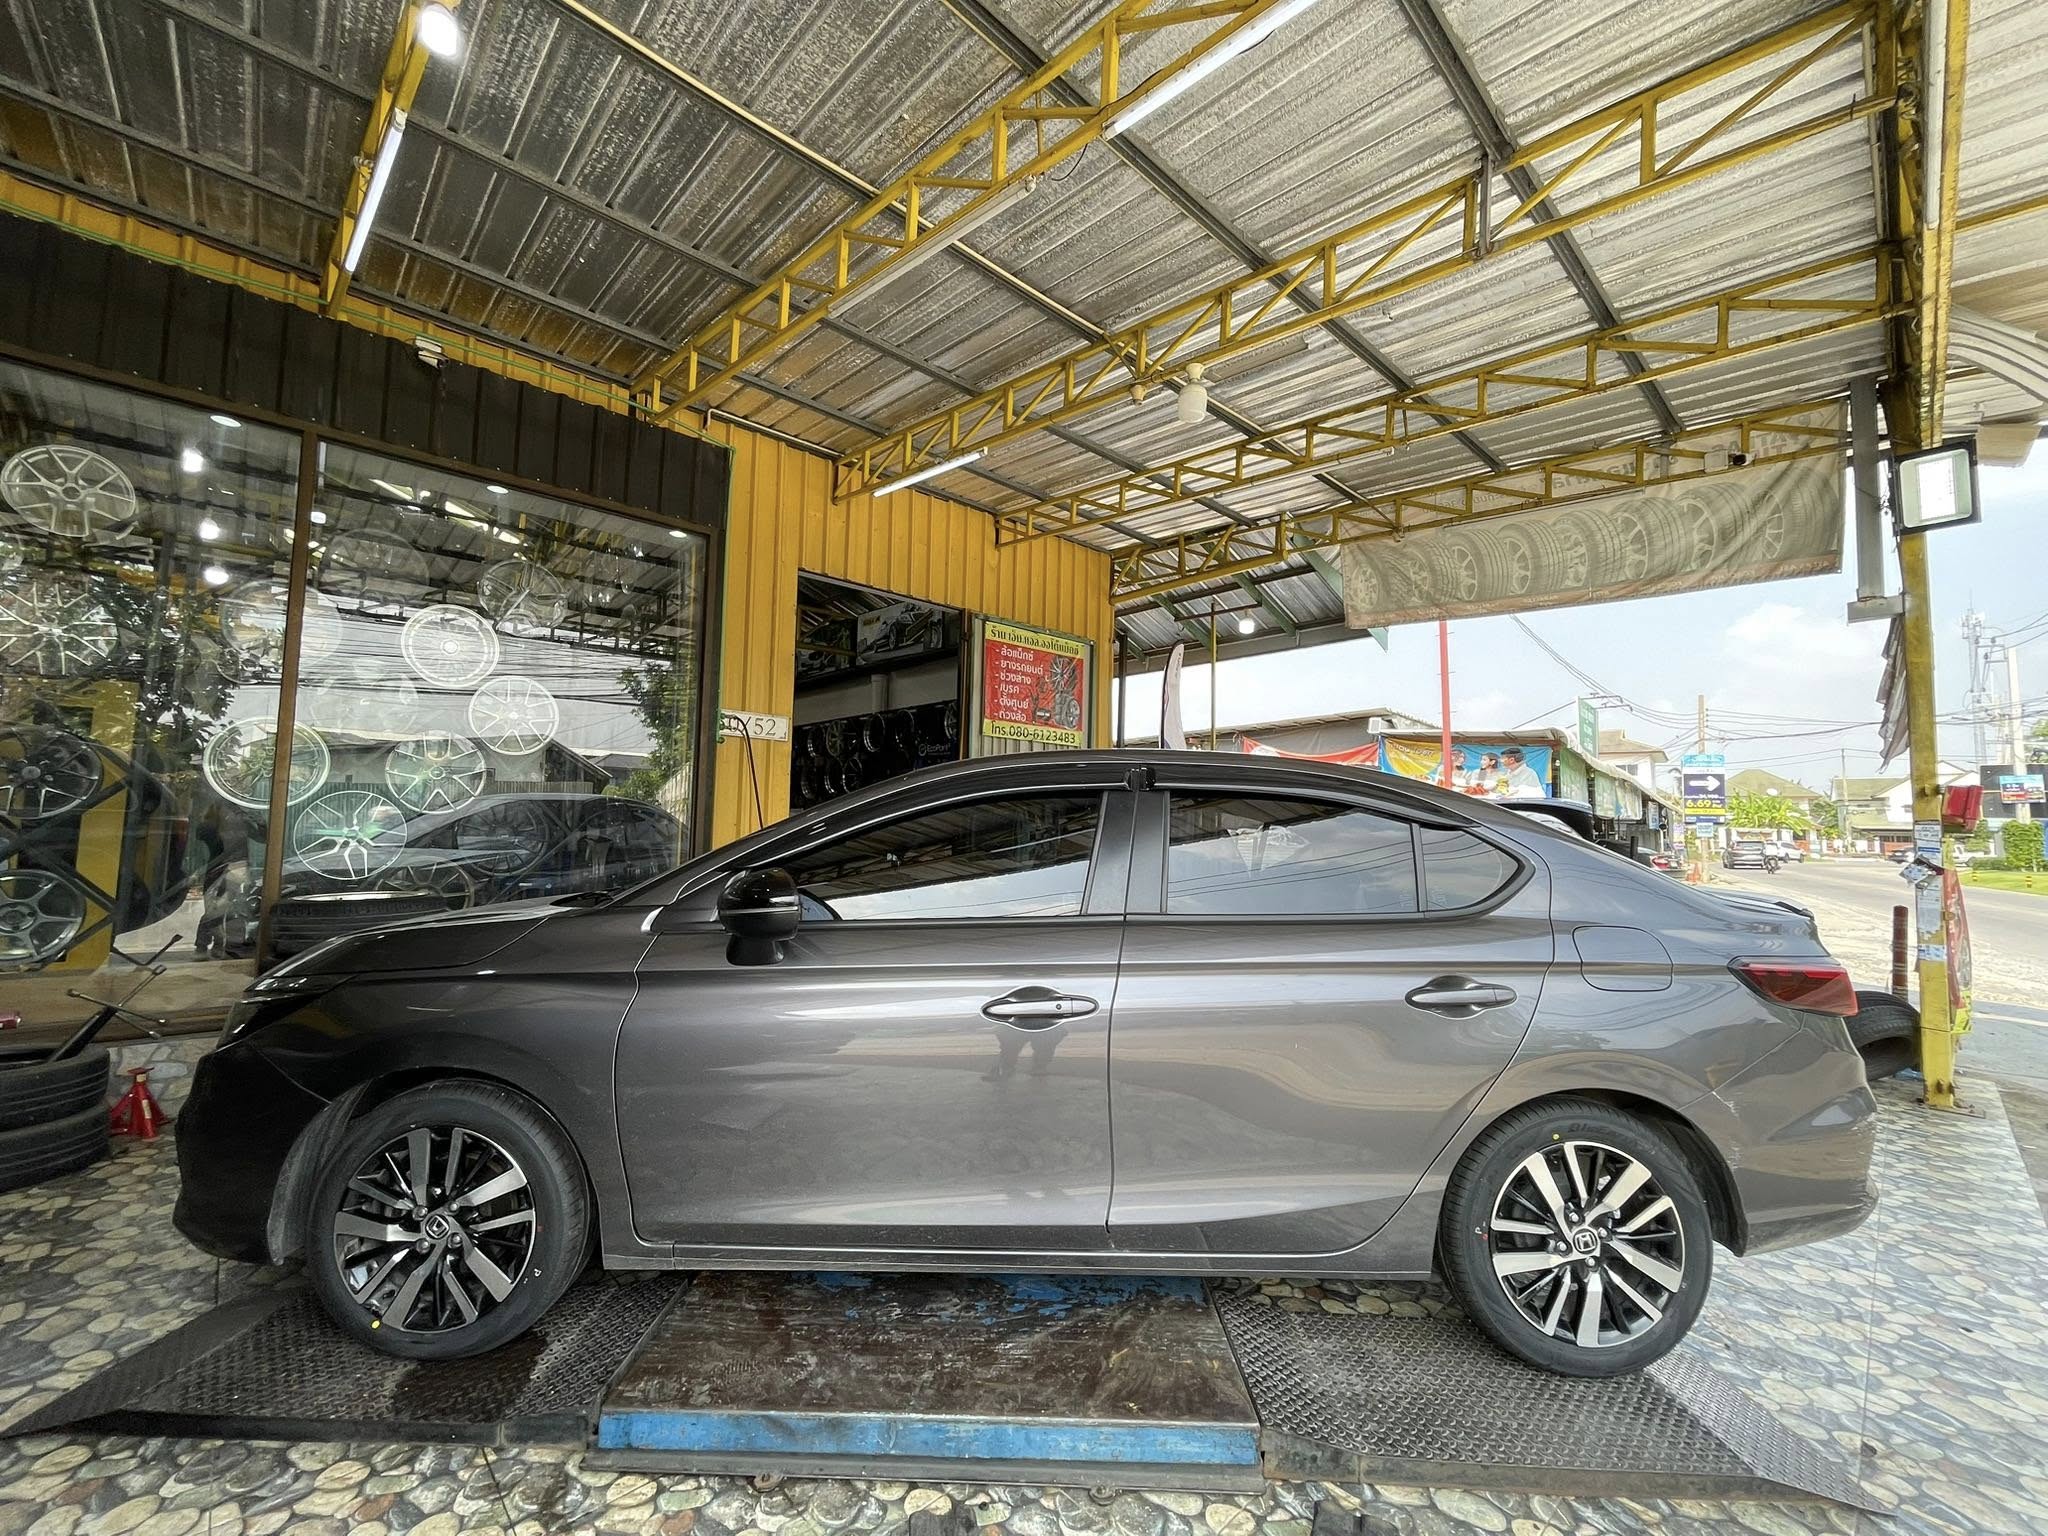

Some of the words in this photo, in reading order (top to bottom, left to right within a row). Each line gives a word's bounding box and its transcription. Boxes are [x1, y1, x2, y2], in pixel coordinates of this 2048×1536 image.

[991, 625, 1006, 639] ร้าน
[1000, 660, 1043, 675] ยางรถยนต์
[1000, 670, 1031, 684] ช่วงล่าง
[999, 692, 1029, 711] ตั้งศูนย์
[999, 708, 1027, 722] ถ่วงล้อ
[1685, 799, 1712, 808] 6.69
